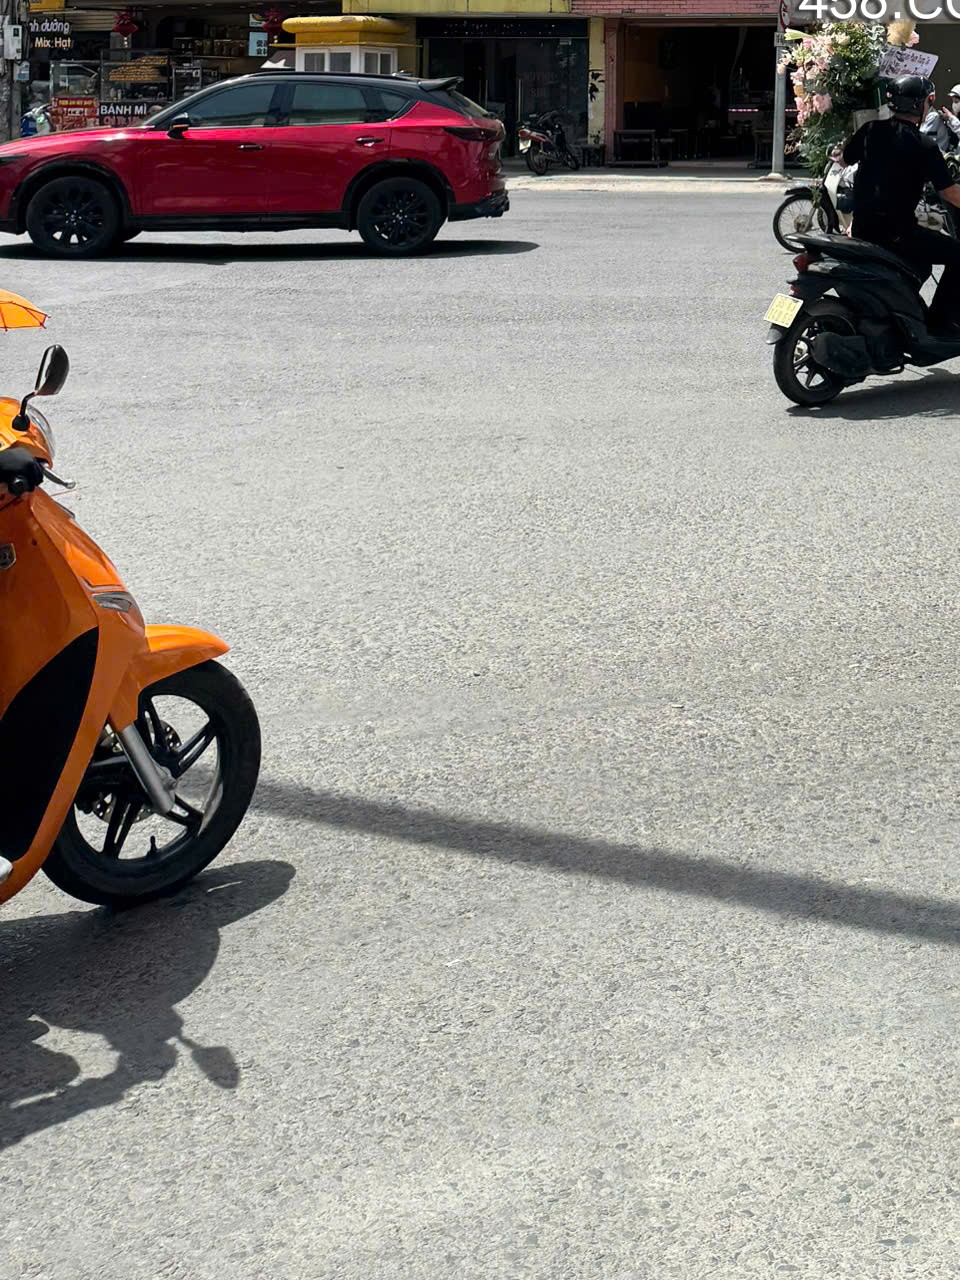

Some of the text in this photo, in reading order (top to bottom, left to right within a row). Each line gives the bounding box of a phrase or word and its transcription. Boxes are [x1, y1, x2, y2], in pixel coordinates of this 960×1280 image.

[41, 19, 70, 34] dưỡng
[35, 36, 51, 48] Mix
[101, 103, 132, 116] BÁNH
[134, 103, 147, 116] MÌ
